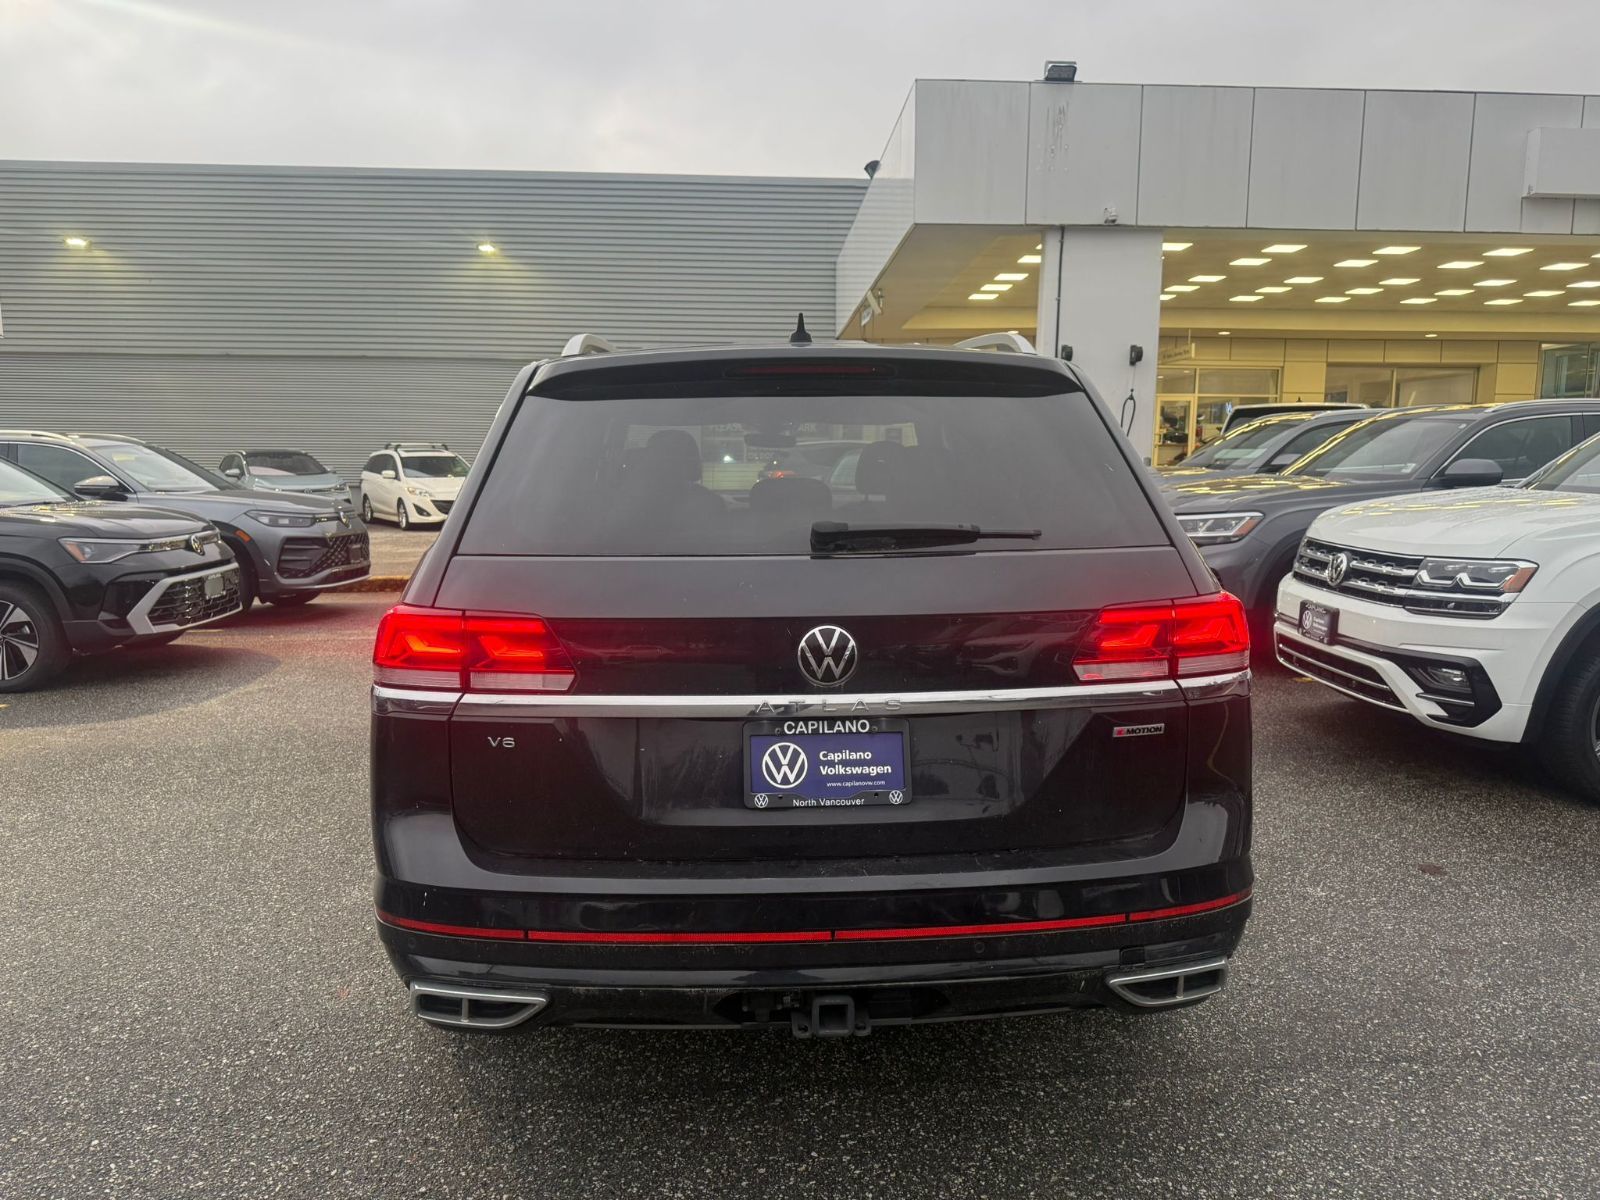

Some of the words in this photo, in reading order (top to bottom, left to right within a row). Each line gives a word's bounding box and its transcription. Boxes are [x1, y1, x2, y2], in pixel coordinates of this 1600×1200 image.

[756, 699, 902, 713] ATLAS
[783, 719, 870, 735] CAPILANO
[487, 736, 515, 748] V6
[819, 750, 872, 762] Capilano
[819, 763, 892, 777] Volkswagen
[793, 799, 817, 808] North
[820, 798, 865, 807] Vancouver
